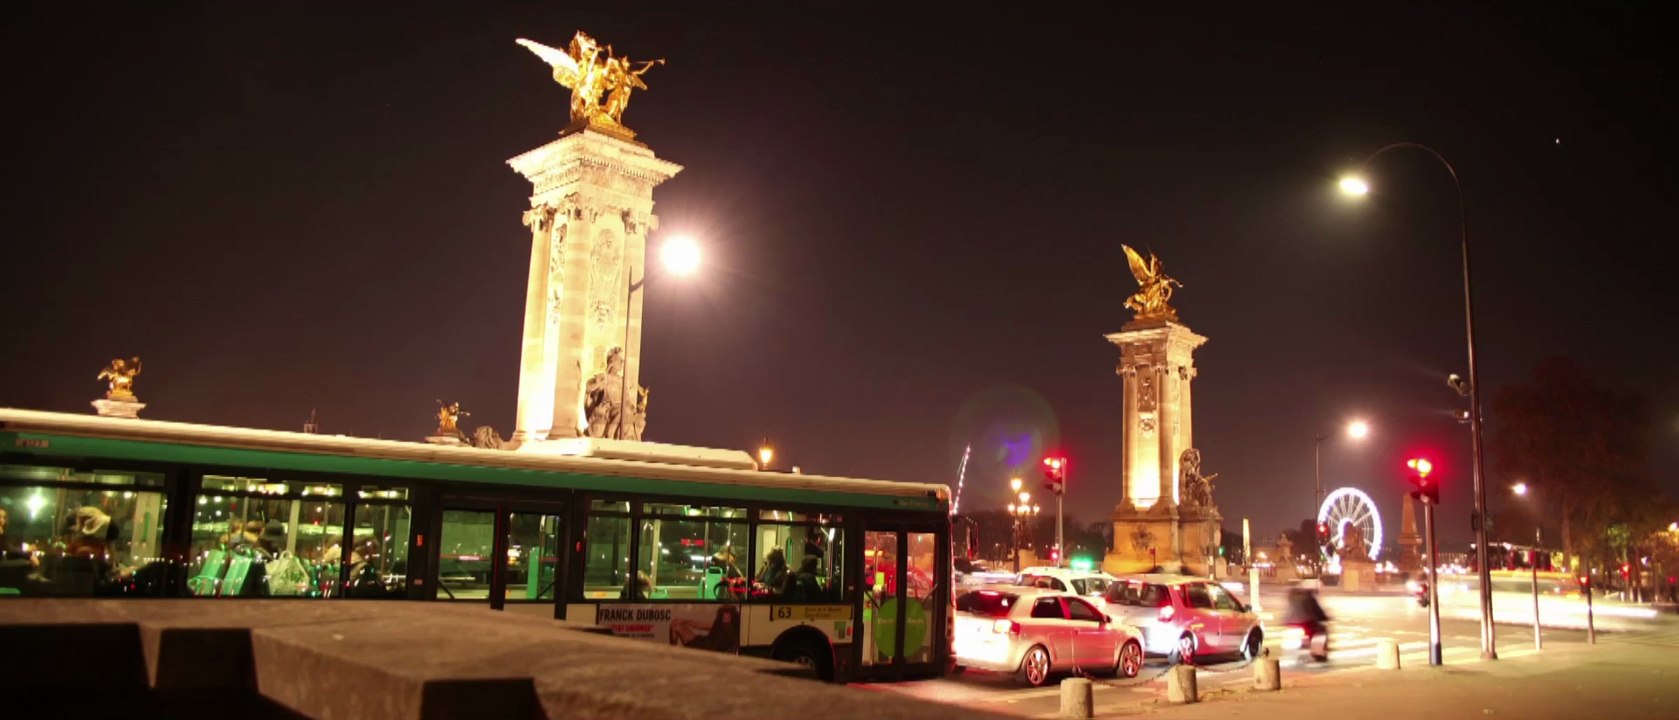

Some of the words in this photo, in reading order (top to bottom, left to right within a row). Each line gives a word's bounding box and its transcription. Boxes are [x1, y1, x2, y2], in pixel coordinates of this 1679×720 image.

[600, 608, 633, 621] FRANCK
[637, 609, 671, 622] DUBOSC
[778, 607, 791, 619] 63
